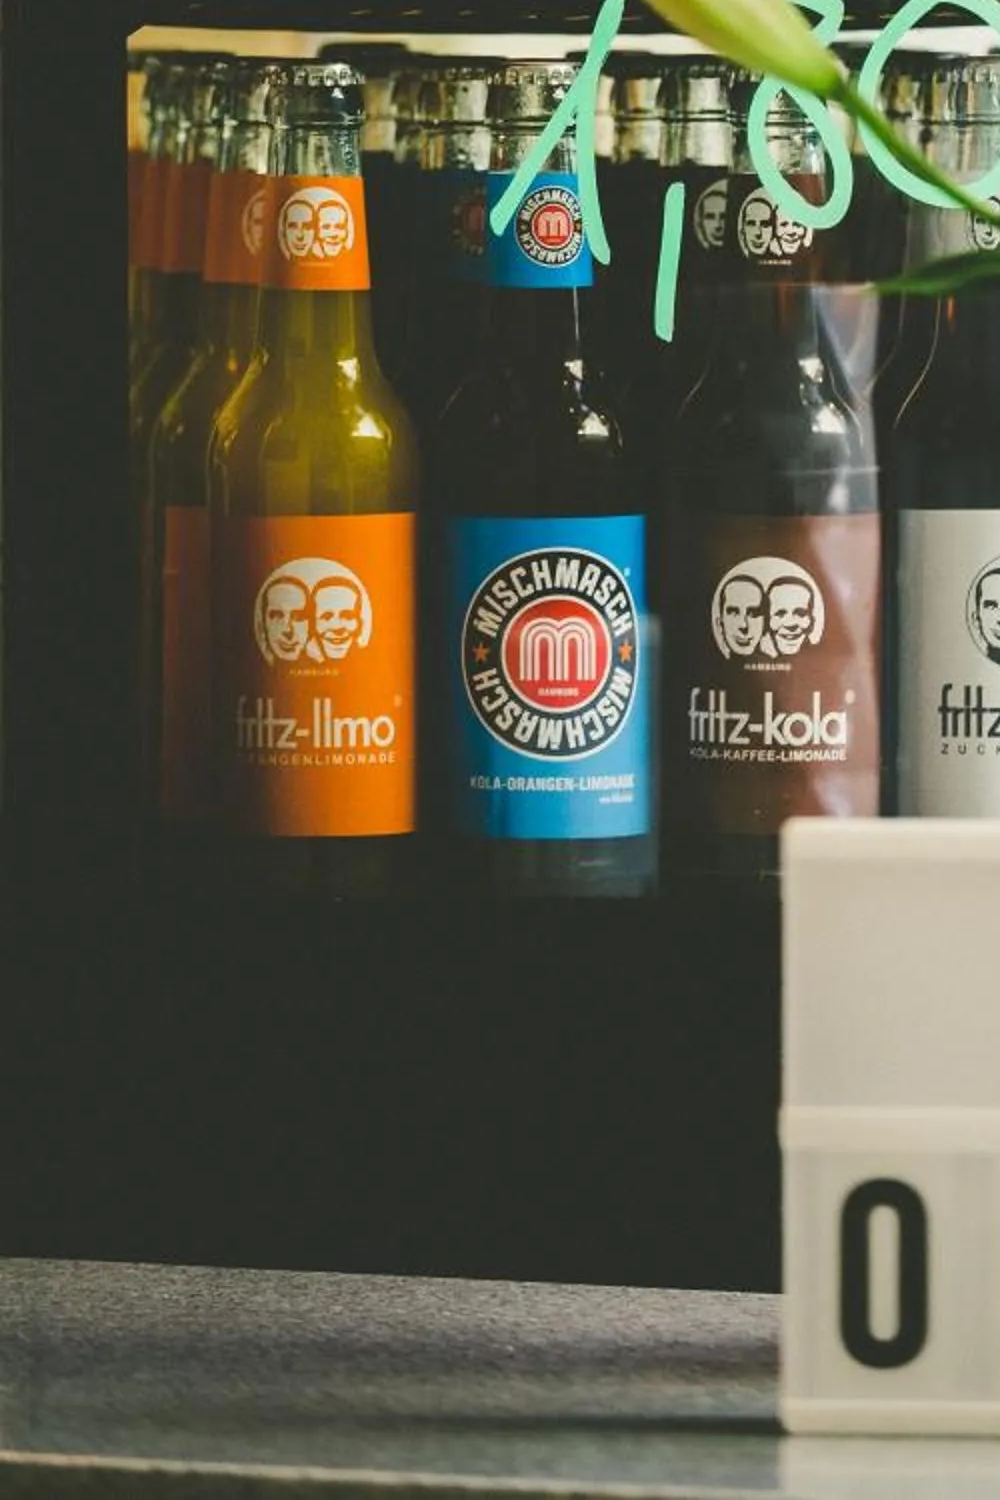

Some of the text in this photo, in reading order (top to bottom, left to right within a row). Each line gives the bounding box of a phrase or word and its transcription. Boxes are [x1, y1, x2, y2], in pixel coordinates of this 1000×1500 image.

[474, 557, 633, 638] MISCHMASCH
[237, 694, 396, 748] fritz-limo
[472, 666, 634, 751] MISCHMASCH
[688, 687, 848, 747] fritz-kola
